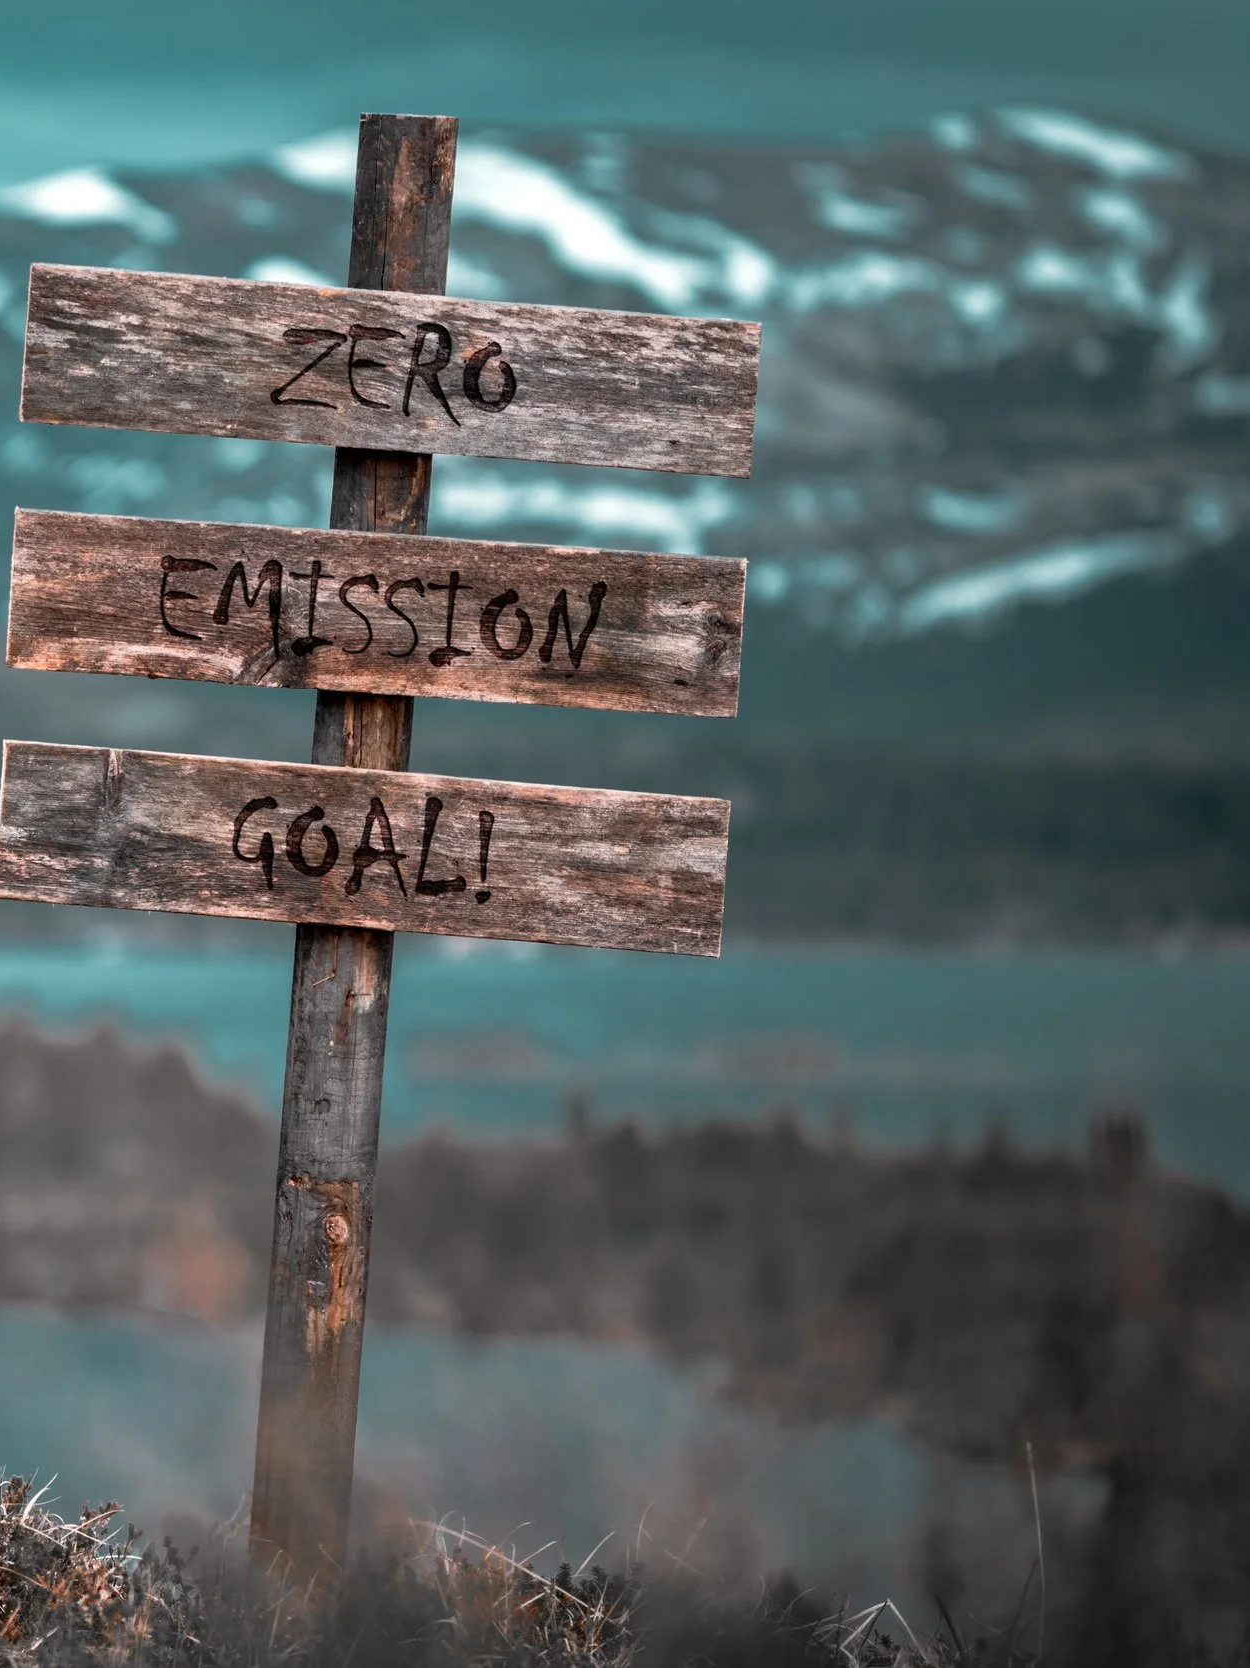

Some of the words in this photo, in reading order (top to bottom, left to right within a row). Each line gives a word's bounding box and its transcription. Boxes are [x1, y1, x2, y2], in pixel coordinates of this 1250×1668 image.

[270, 322, 517, 427] ZERO
[160, 554, 607, 669] EMISSION
[232, 796, 495, 904] GOAL!
